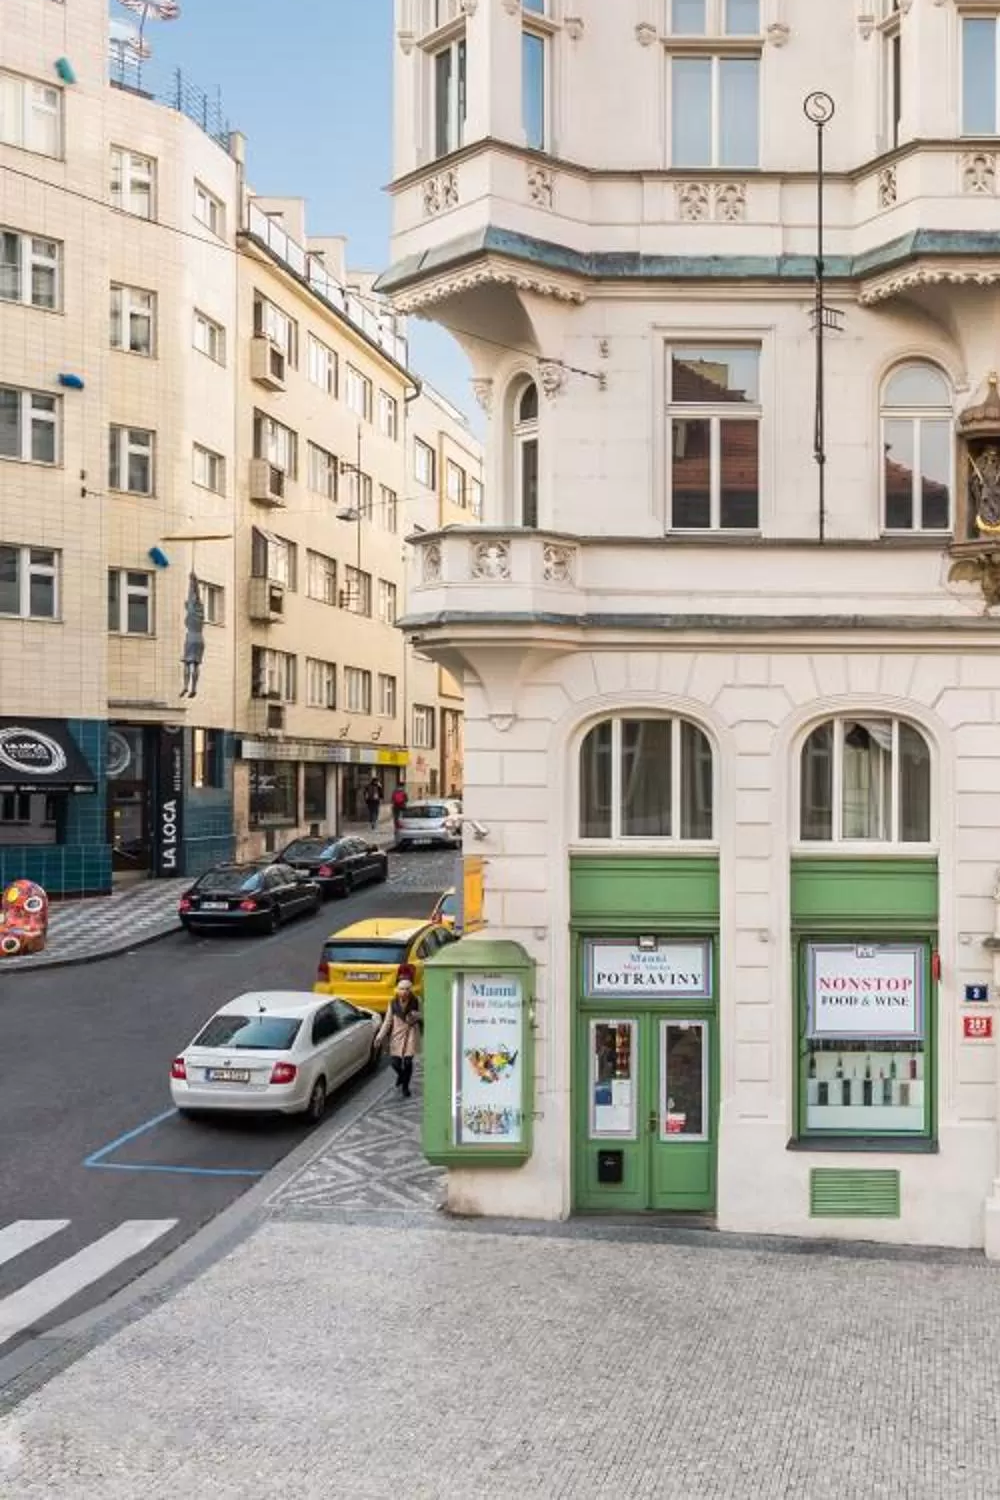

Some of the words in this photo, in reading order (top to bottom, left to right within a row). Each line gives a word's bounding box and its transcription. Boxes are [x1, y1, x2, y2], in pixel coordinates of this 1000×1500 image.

[162, 799, 177, 844] LOCA
[162, 847, 177, 869] LA
[597, 972, 701, 986] POTRAVINY
[820, 977, 912, 991] NONSTOP
[821, 995, 858, 1005] FOOD
[874, 995, 909, 1006] WINE
